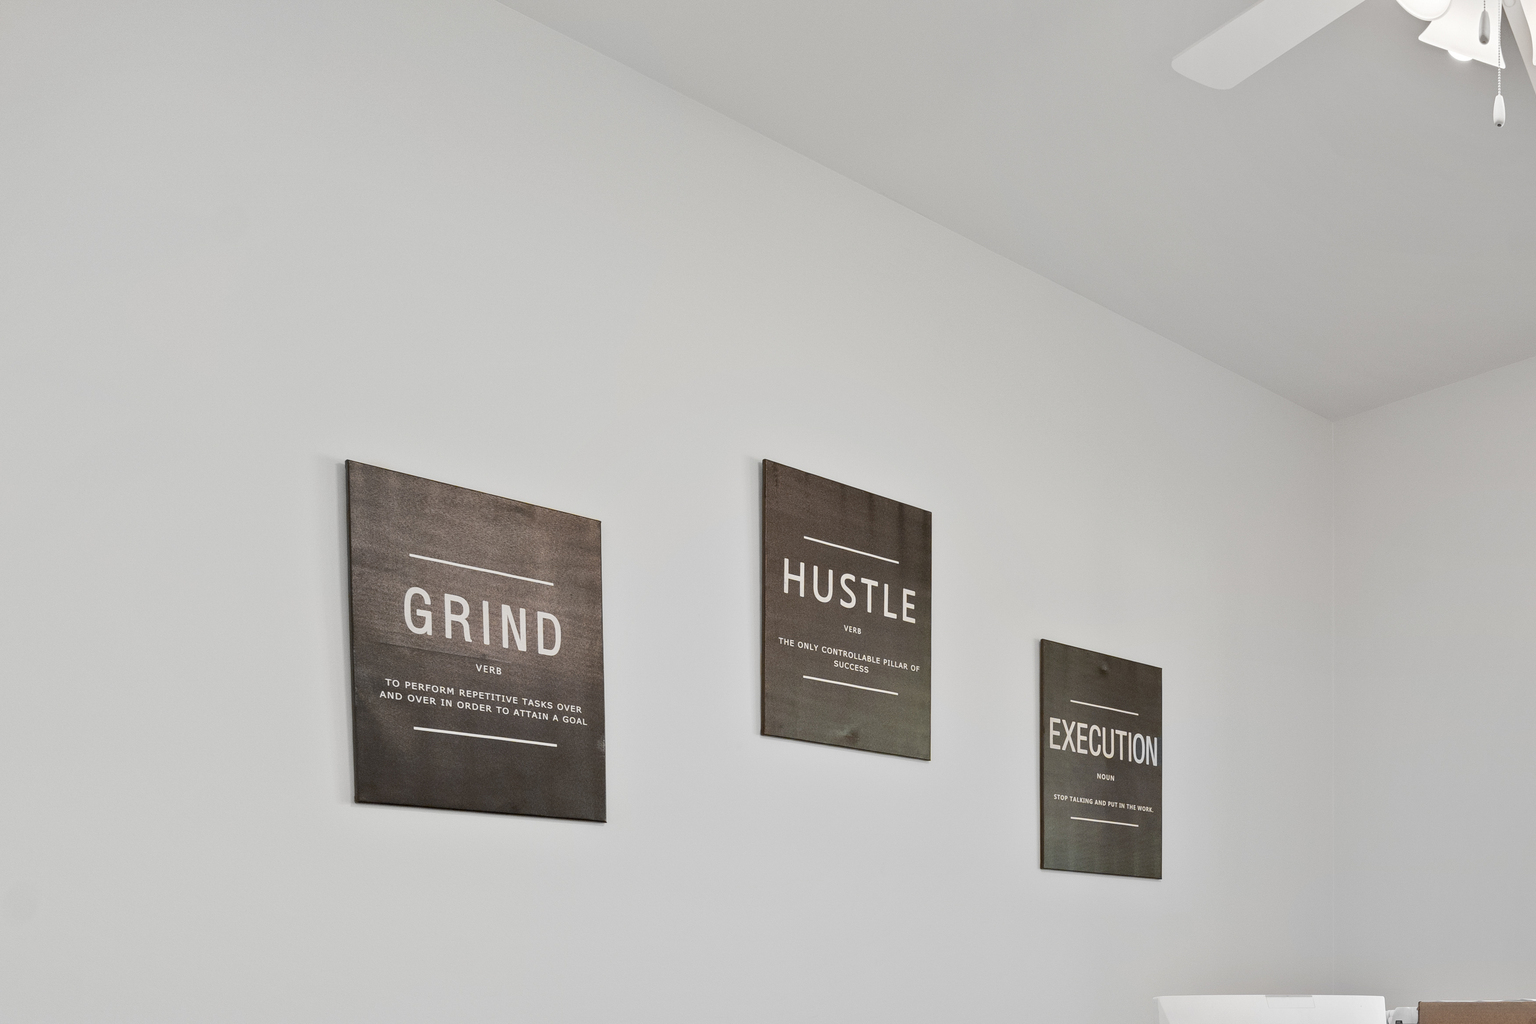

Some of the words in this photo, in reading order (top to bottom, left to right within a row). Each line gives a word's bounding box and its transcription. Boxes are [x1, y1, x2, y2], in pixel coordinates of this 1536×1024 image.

[783, 557, 916, 624] HUSTLE
[403, 587, 562, 656] GRIND
[843, 624, 862, 635] VERB
[475, 663, 502, 675] VERB
[778, 636, 795, 648] THE
[797, 641, 819, 652] ONLY
[821, 645, 881, 665] CONTROLLABLE
[882, 658, 908, 670] PILLAR
[910, 664, 920, 673] OF
[833, 660, 869, 674] SUCCESS
[379, 690, 403, 700] AND
[407, 693, 437, 706] OVER
[441, 698, 453, 707] IN
[456, 700, 493, 713] ORDER
[495, 705, 511, 715] TO
[513, 708, 549, 721] ATTAIN
[552, 713, 559, 722] A
[562, 715, 588, 726] GOAL
[385, 678, 400, 688] TO
[404, 681, 455, 696] PERFORM
[459, 688, 519, 704] REPETITIVE
[522, 697, 553, 710] TASKS
[556, 703, 582, 714] OVER
[1049, 716, 1158, 767] EXECUTION
[1096, 772, 1115, 782] NOUN
[1053, 793, 1068, 801] STOP
[1069, 795, 1093, 805] TALKING
[1094, 799, 1107, 807] AND
[1107, 800, 1118, 808] PUT
[1126, 803, 1136, 811] THE
[1137, 805, 1154, 813] WORK.
